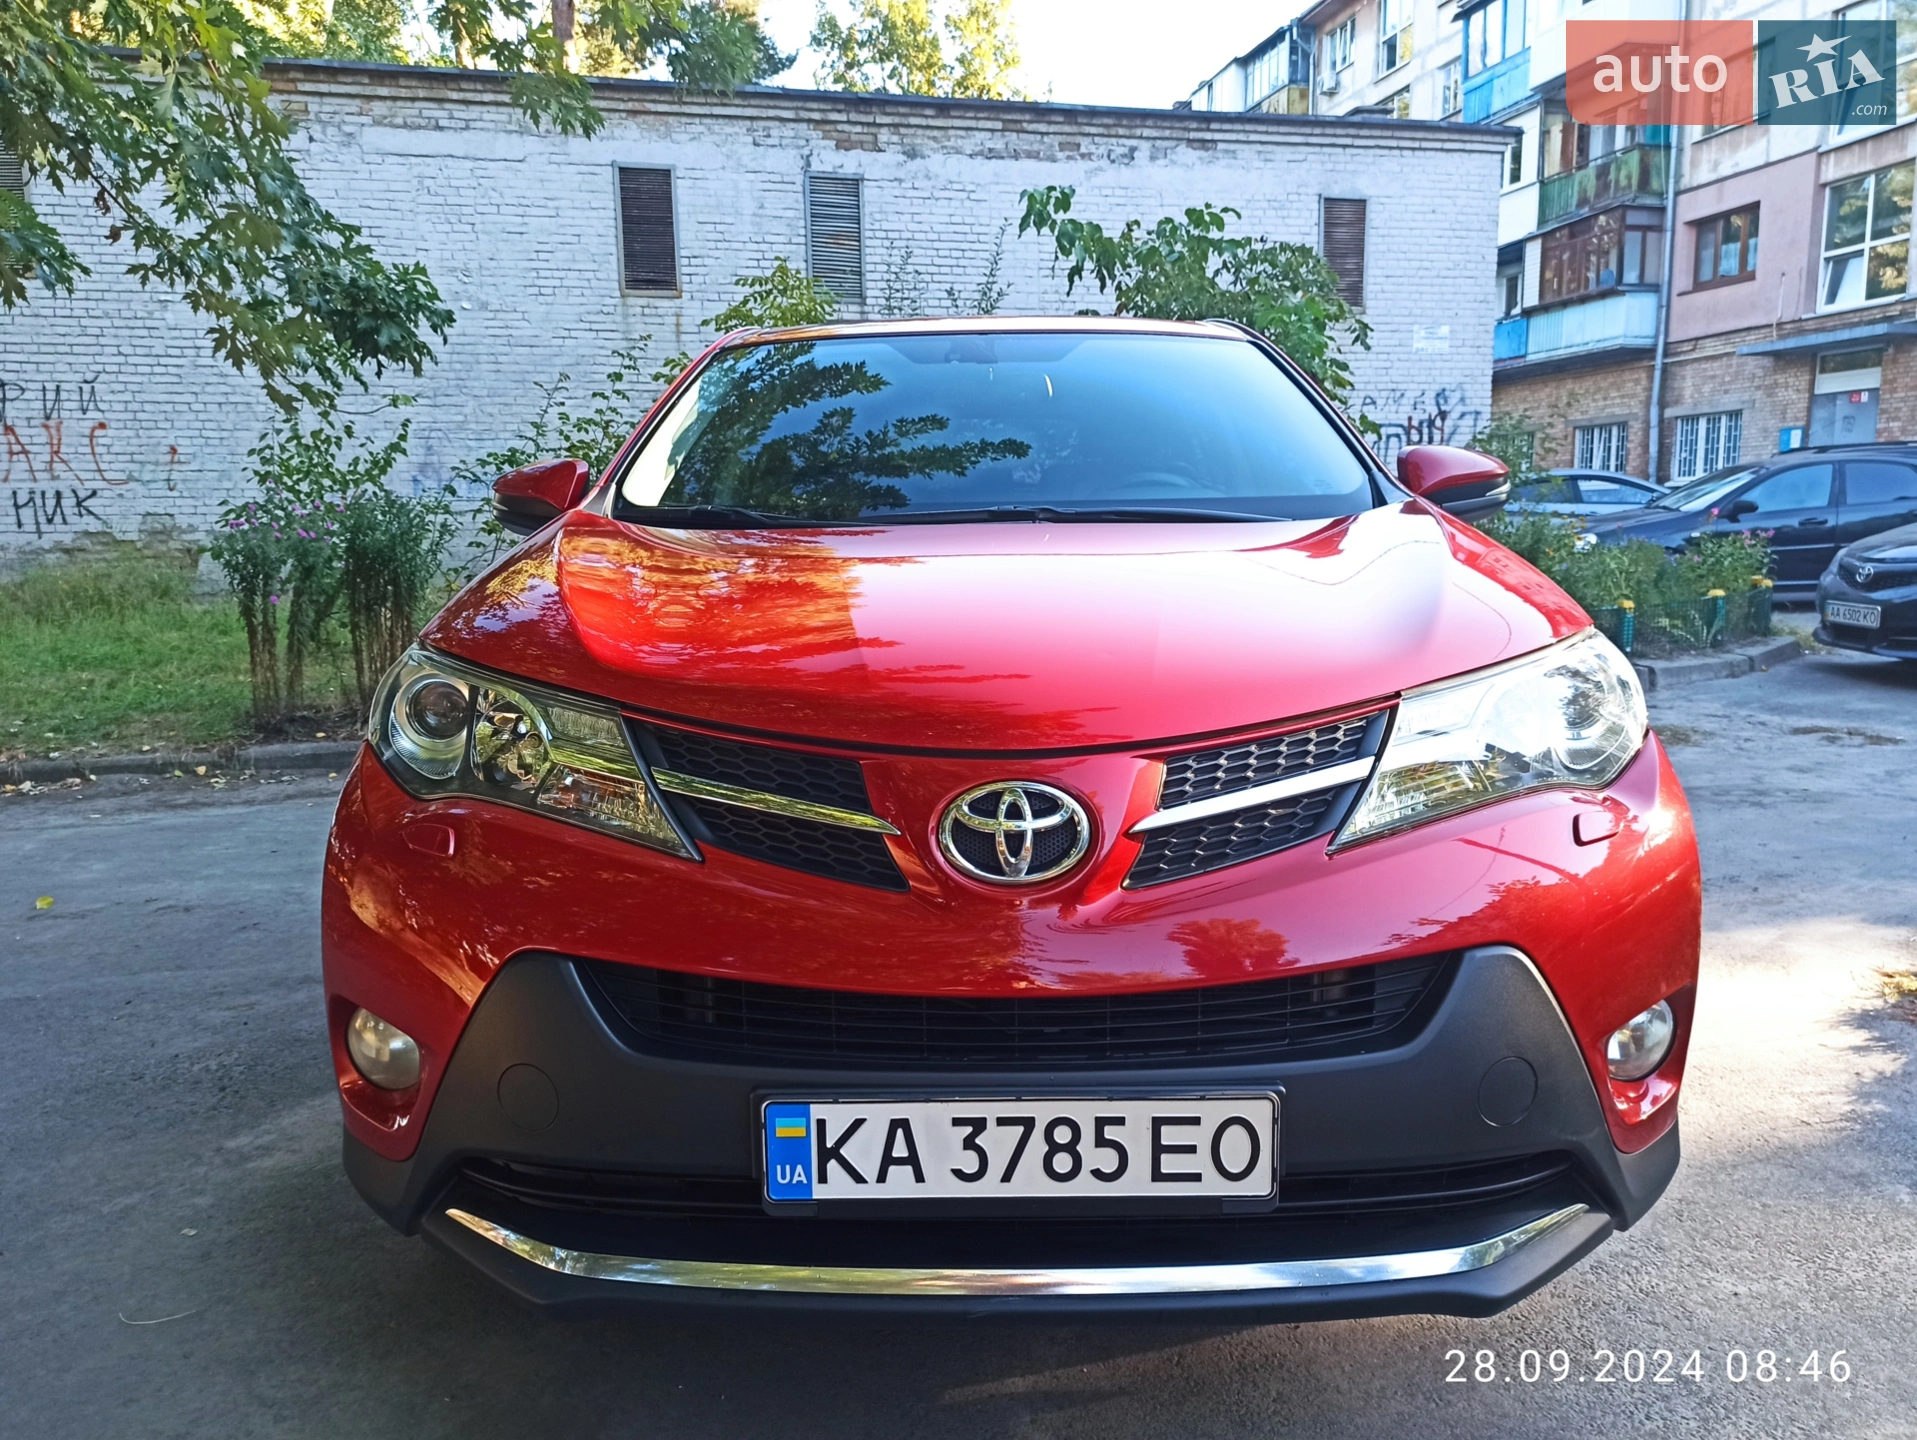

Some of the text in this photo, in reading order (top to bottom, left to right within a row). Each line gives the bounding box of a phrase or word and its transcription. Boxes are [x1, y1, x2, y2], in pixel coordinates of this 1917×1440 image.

[1830, 606, 1876, 625] AA 6502 KO
[815, 1115, 1262, 1185] KA 3785 EO
[776, 1164, 808, 1185] UA
